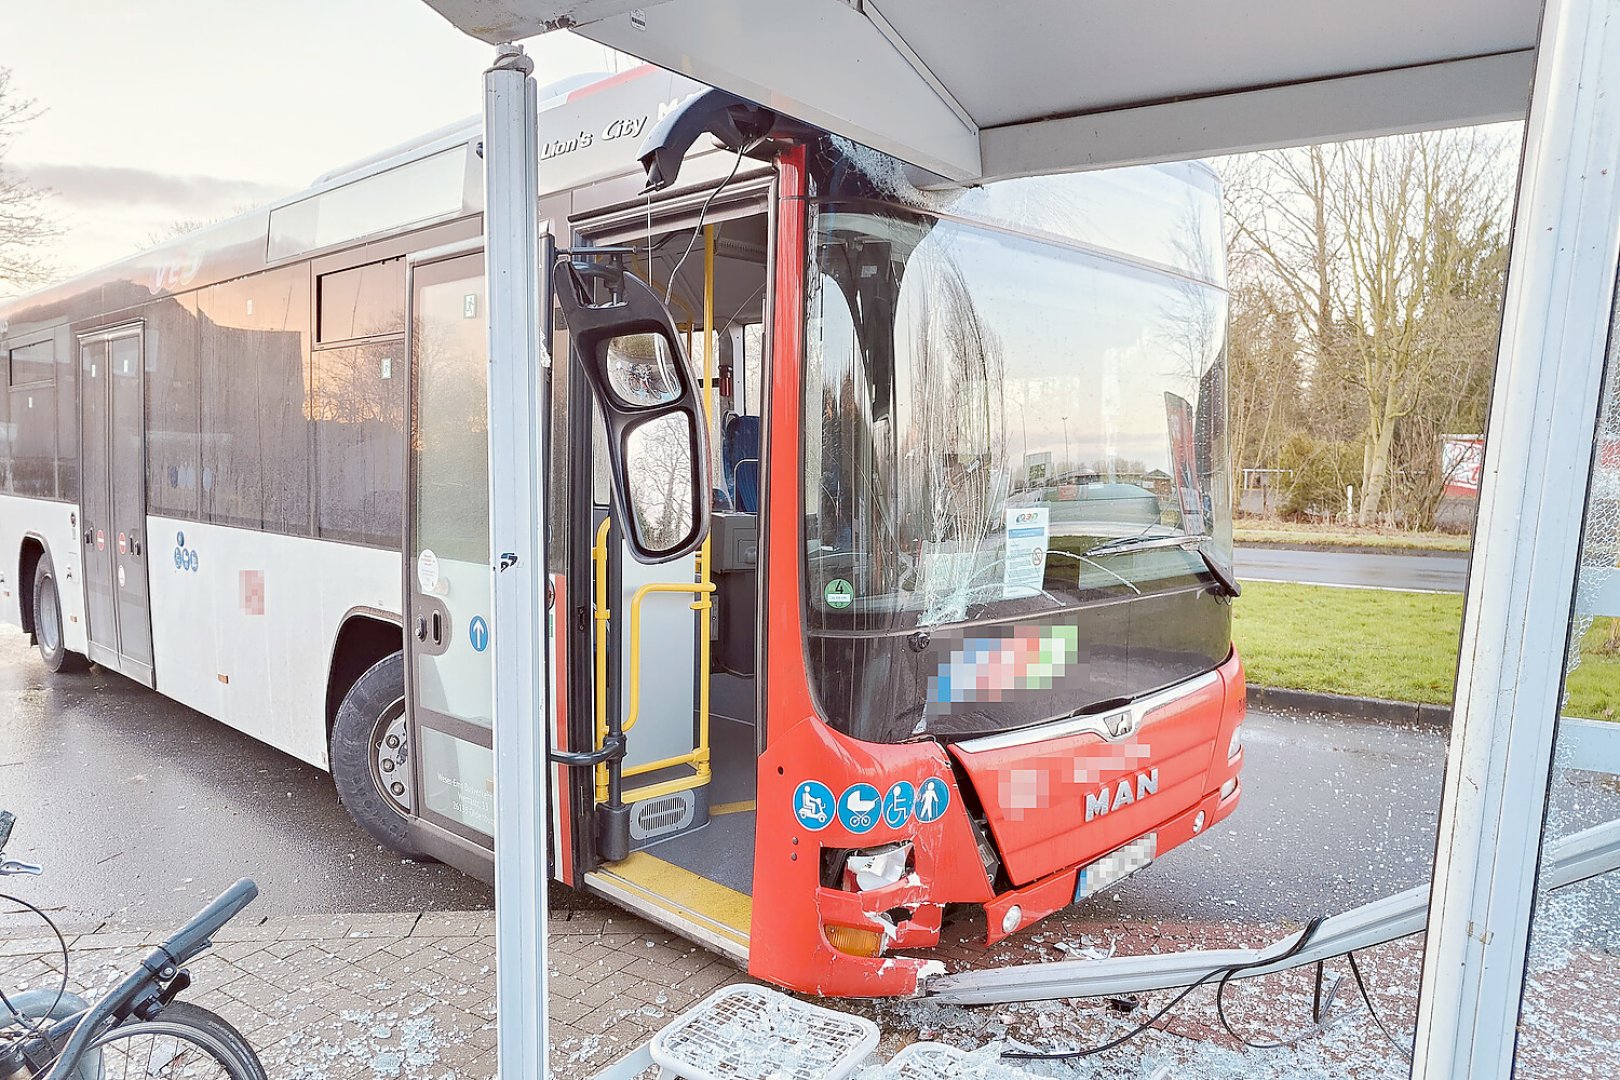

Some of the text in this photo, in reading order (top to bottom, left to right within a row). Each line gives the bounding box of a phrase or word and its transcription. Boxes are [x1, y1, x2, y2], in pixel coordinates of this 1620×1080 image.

[540, 115, 648, 160] Lion's City
[835, 580, 844, 594] 4
[1083, 766, 1159, 823] MAN
